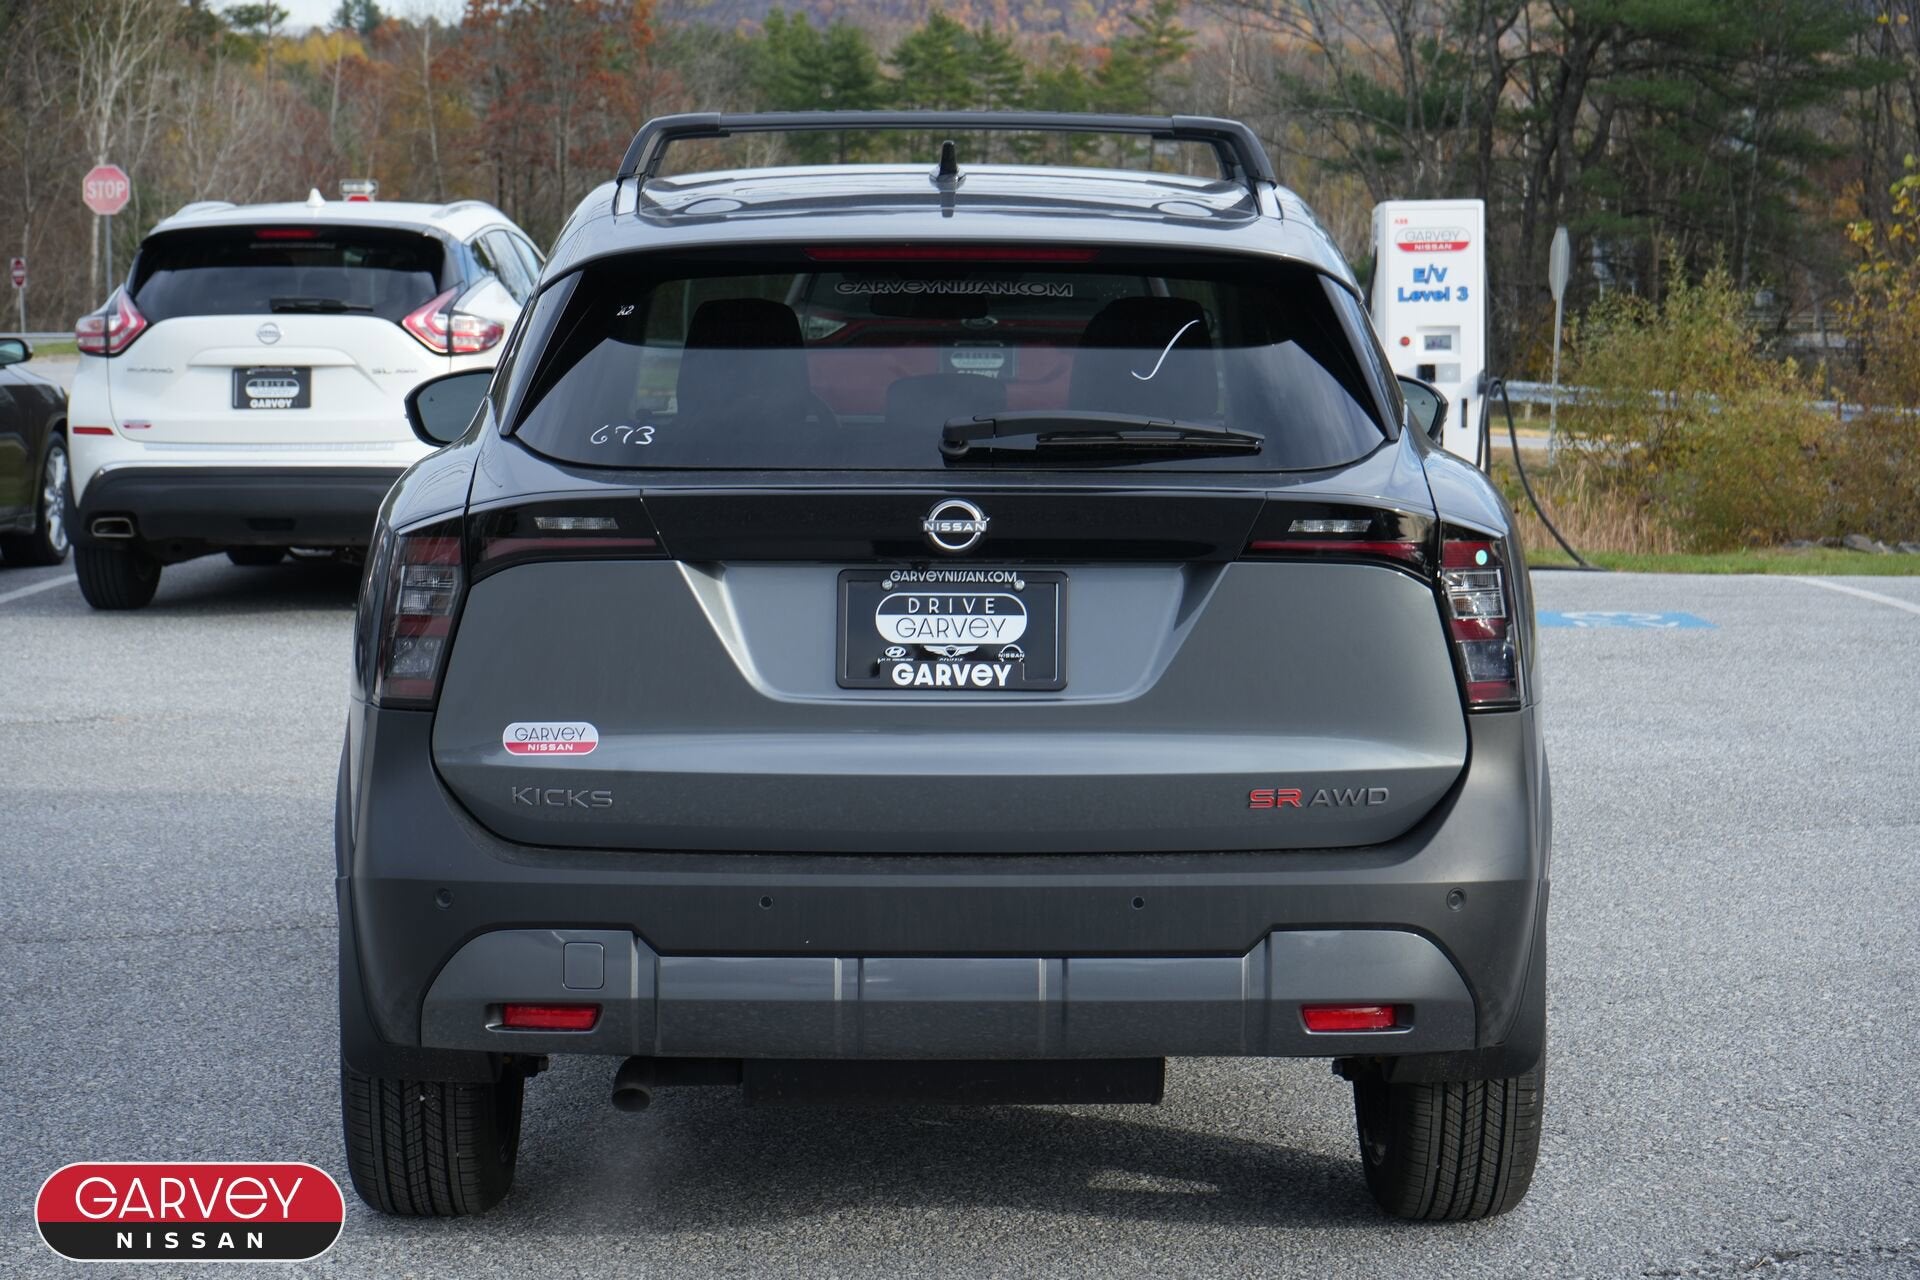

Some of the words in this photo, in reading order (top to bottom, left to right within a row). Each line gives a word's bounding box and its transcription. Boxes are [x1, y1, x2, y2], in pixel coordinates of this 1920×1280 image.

[87, 180, 126, 199] STOP
[1413, 264, 1448, 284] E/V
[1398, 286, 1450, 303] Level
[1456, 286, 1469, 302] 3
[590, 424, 655, 445] 673
[924, 522, 986, 532] NISSAN
[890, 571, 1017, 582] GARVEYNISSAN.COM
[908, 598, 995, 614] DRIVE
[896, 617, 1007, 638] GARVEY
[892, 663, 1012, 686] GARVEY
[514, 727, 586, 742] GARVEY
[527, 743, 574, 751] NISSAN
[512, 786, 613, 808] KICKS
[1249, 788, 1303, 809] SR
[1309, 787, 1390, 807] AWD
